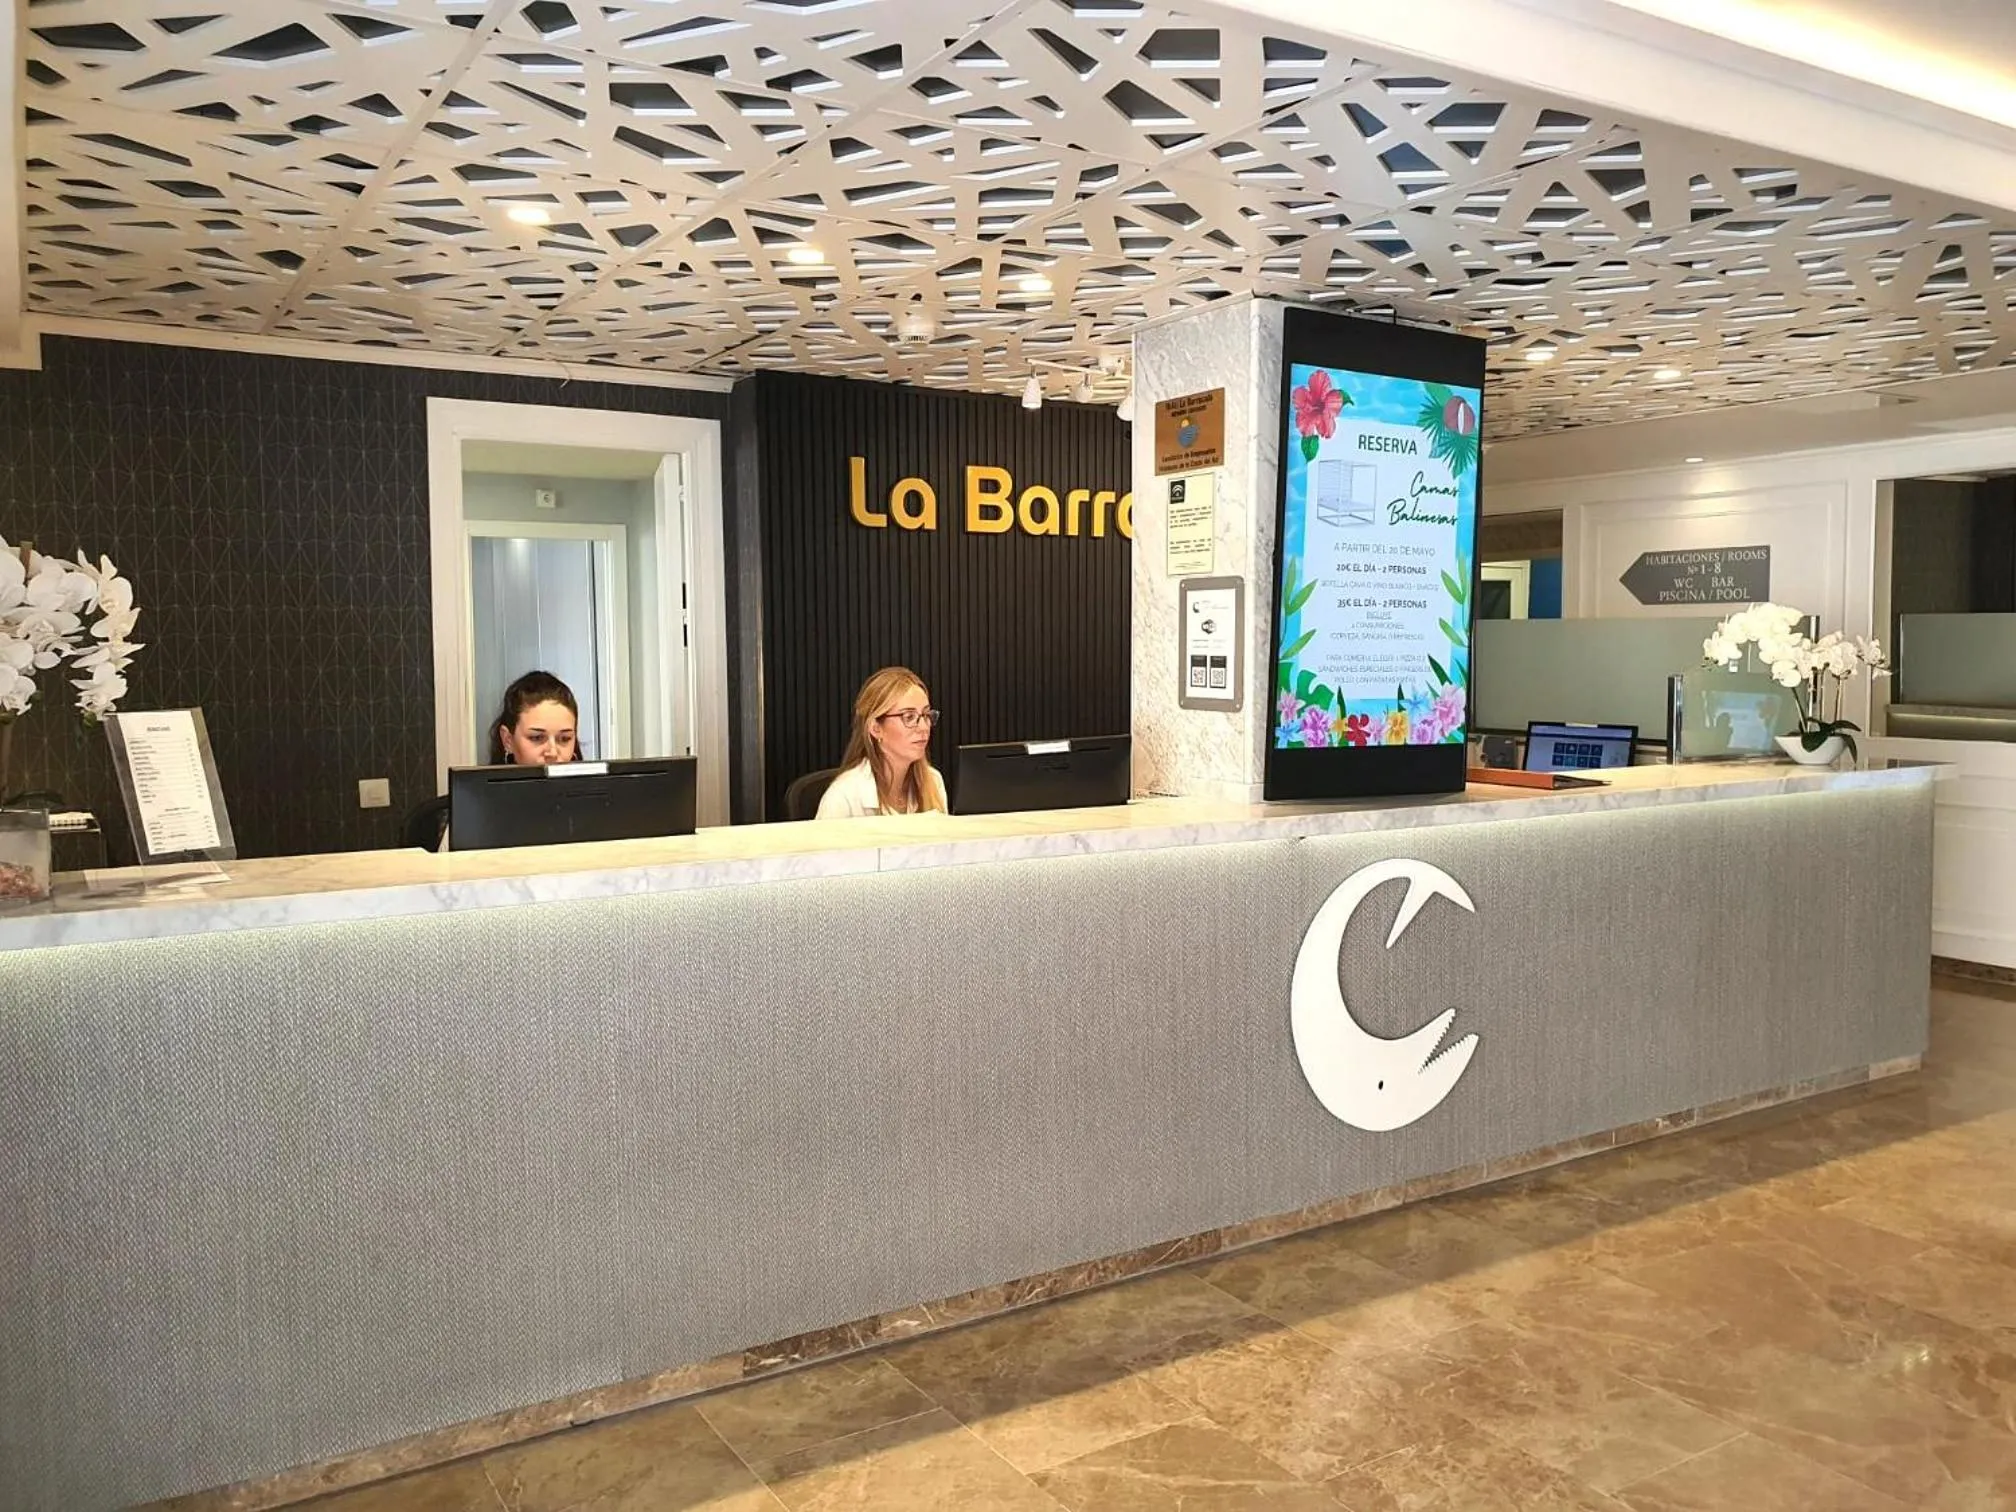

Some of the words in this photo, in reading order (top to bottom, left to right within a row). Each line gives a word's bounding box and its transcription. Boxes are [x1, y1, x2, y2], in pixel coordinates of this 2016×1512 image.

[1358, 434, 1418, 455] RESERVA
[1410, 471, 1459, 498] Camas
[850, 456, 937, 530] La
[1386, 497, 1458, 526] Balinesas
[1334, 543, 1340, 551] A
[1341, 543, 1370, 554] PARTIR
[1372, 544, 1388, 555] DEL
[1400, 545, 1411, 556] DE
[1412, 546, 1436, 557] MAYO
[1645, 553, 1720, 566] HABITACIONES
[1727, 550, 1768, 560] ROOMS
[1352, 564, 1362, 573] EL
[1388, 565, 1427, 575] PERSONAS
[1714, 563, 1721, 574] 8
[1673, 578, 1694, 589] WC
[1711, 577, 1735, 587] BAR
[1659, 590, 1705, 601] PISCINA
[1716, 588, 1751, 600] POOL
[1353, 600, 1363, 608] EL
[1388, 600, 1427, 609] PERSONAS
